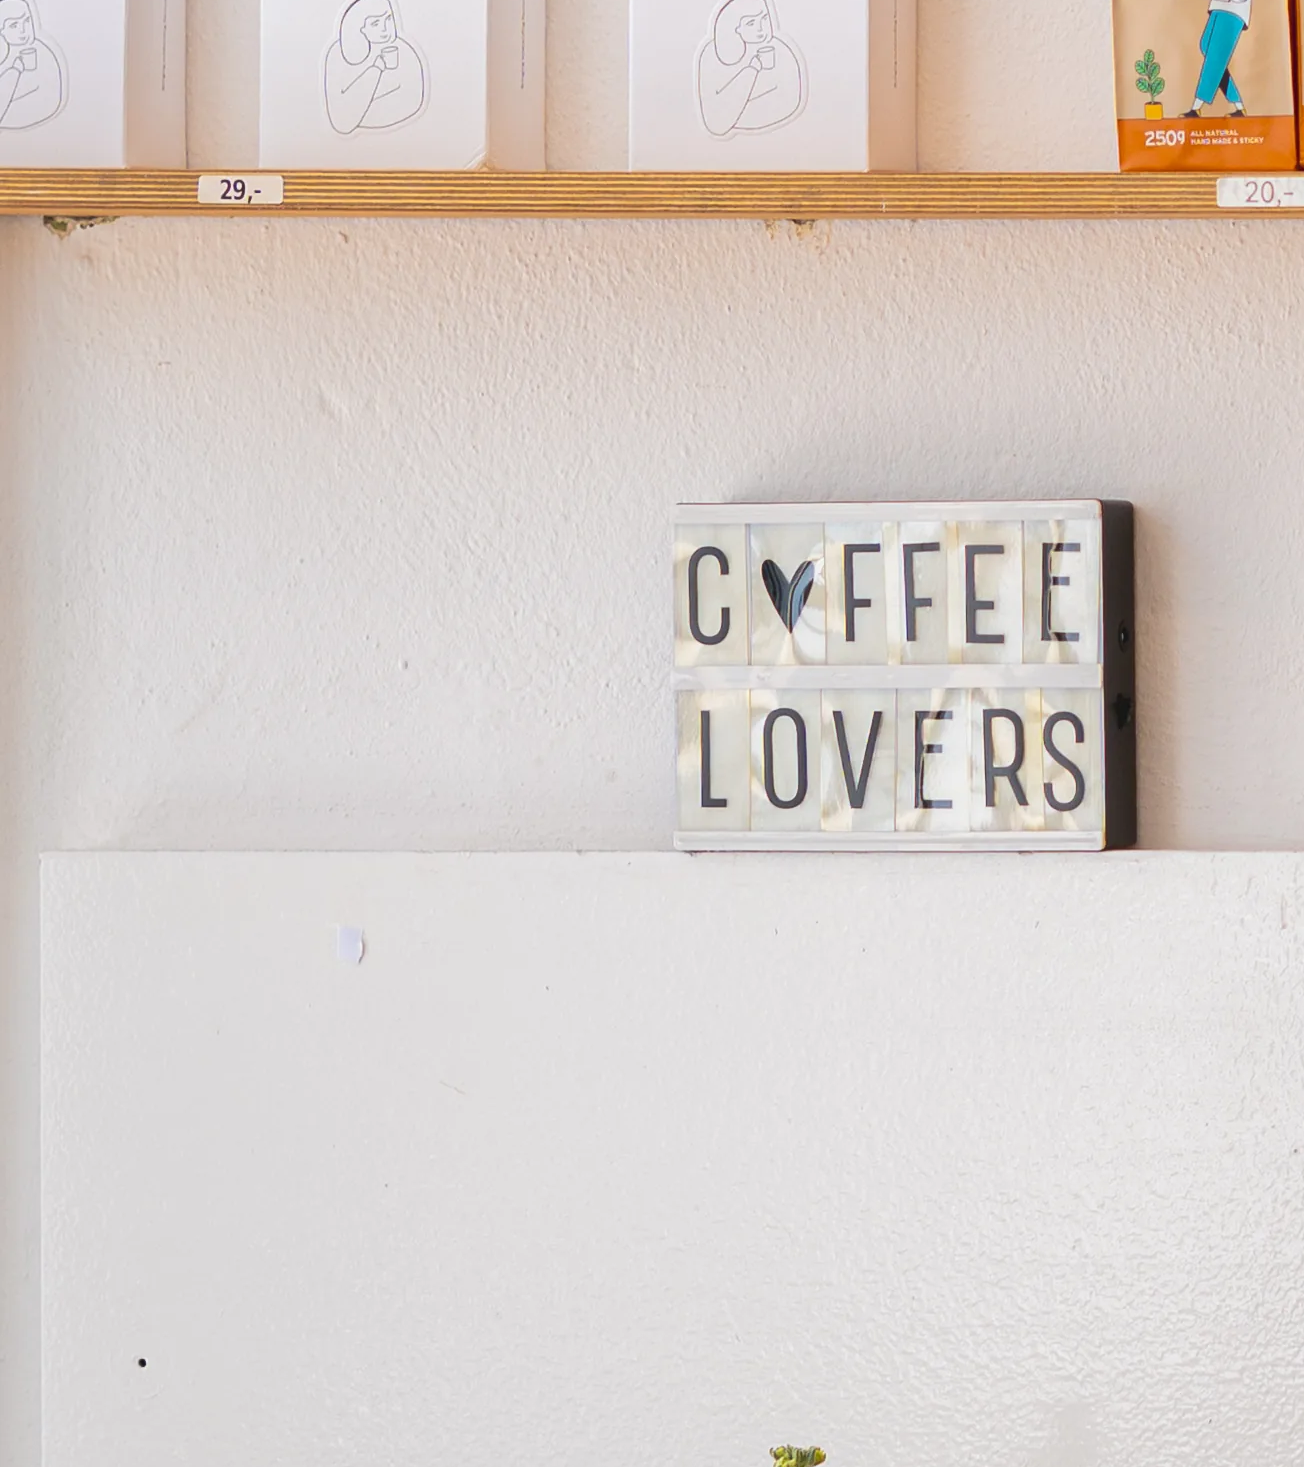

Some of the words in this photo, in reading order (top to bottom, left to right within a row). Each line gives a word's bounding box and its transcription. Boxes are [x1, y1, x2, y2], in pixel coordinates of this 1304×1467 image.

[1144, 130, 1186, 147] 250g
[220, 179, 261, 204] 29,-
[1245, 181, 1294, 207] 20,-
[700, 707, 1086, 812] LOVERS
